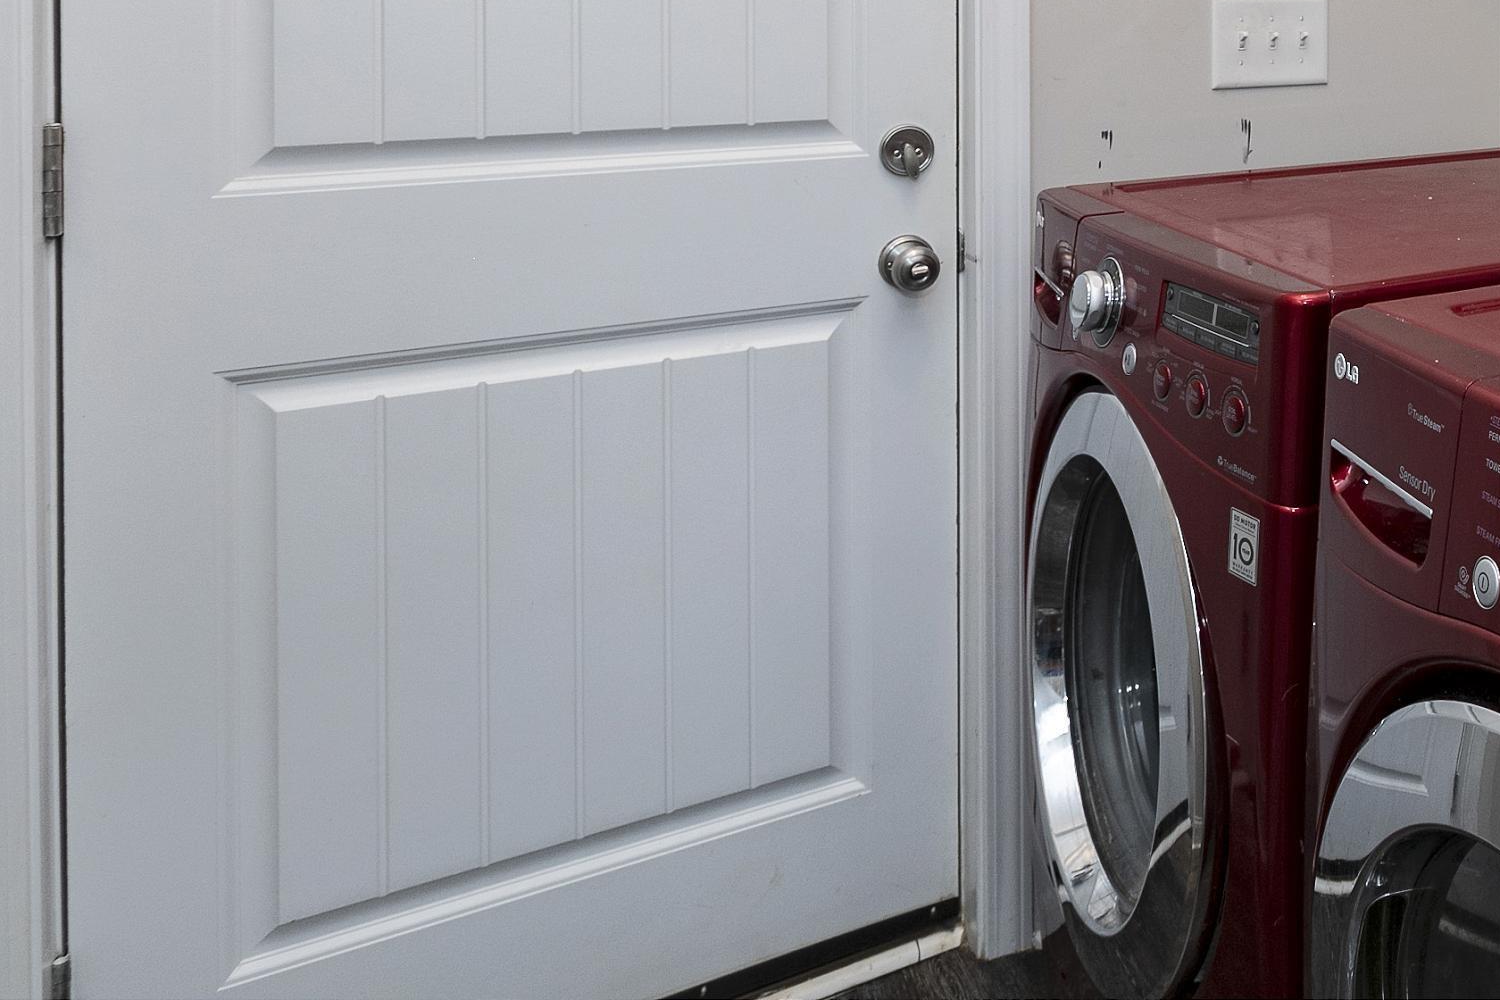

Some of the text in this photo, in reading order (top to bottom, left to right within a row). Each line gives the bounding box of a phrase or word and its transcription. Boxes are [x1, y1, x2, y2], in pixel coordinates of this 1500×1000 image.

[1399, 465, 1436, 502] Sensor Dry
[1481, 490, 1498, 508] STEAM
[1476, 525, 1495, 544] STEAM
[1233, 532, 1254, 566] 10
